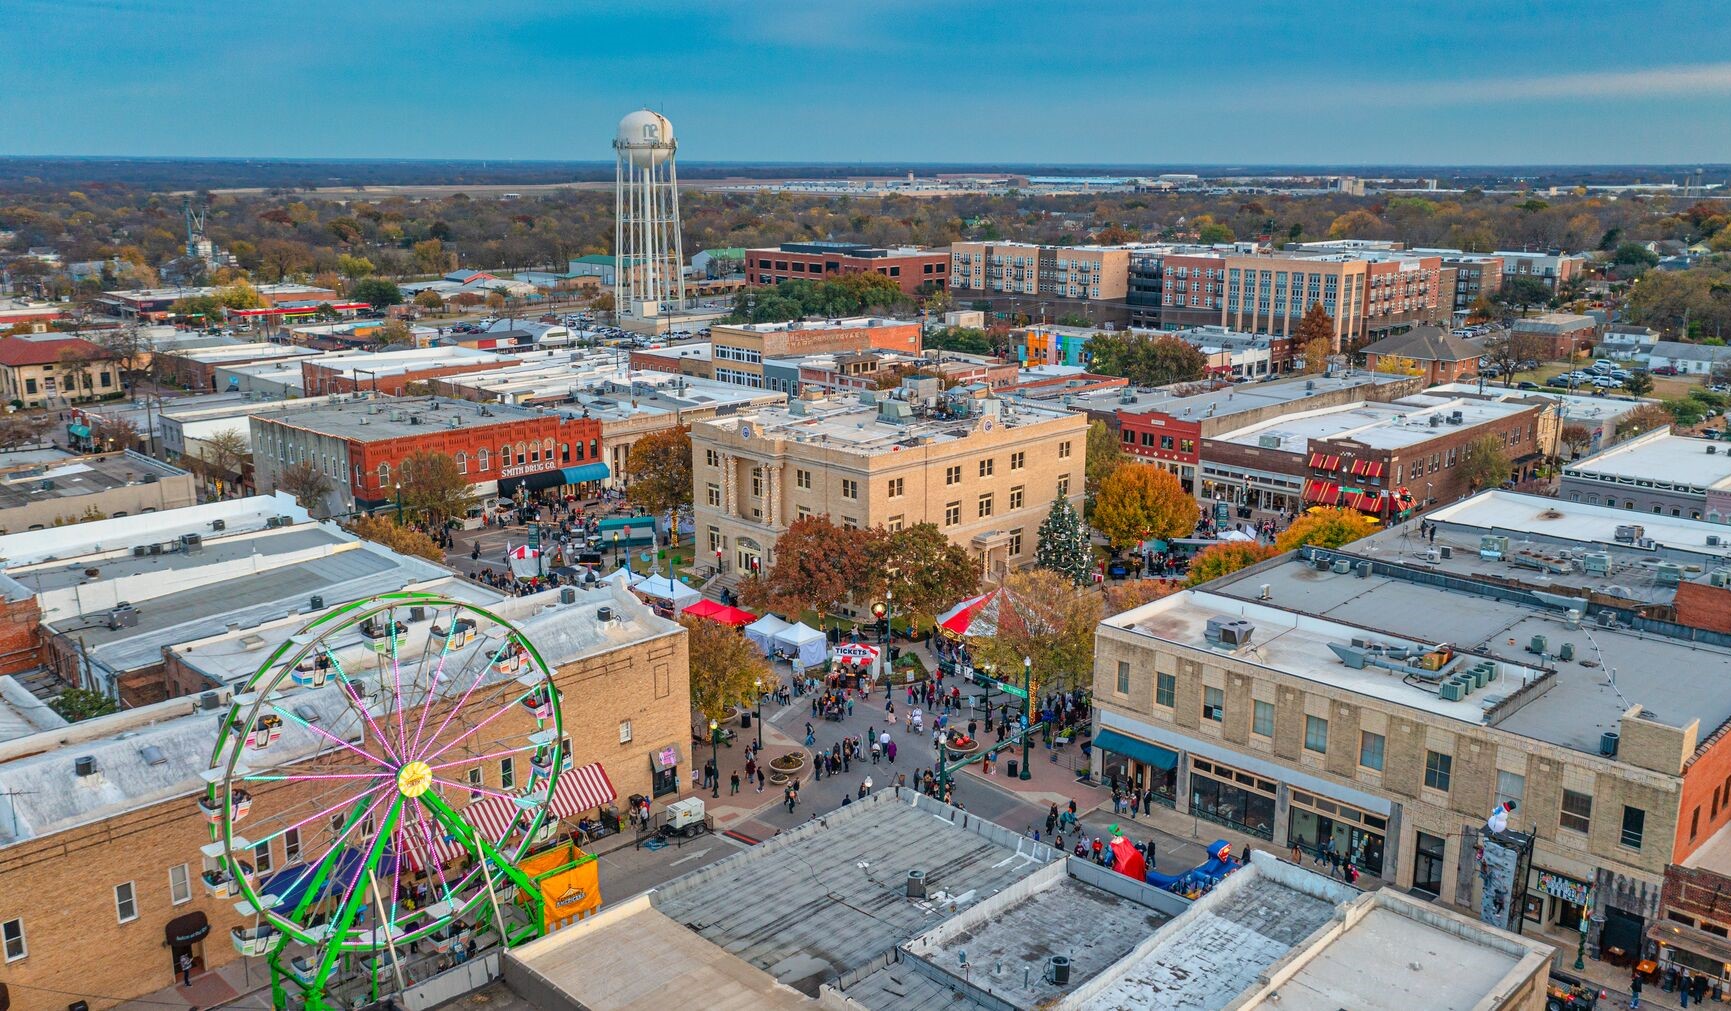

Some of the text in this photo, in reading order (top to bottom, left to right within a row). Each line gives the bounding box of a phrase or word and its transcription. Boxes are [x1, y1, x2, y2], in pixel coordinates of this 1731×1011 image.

[501, 461, 556, 478] SMITH DRUG CO.
[835, 647, 868, 656] TICKETS
